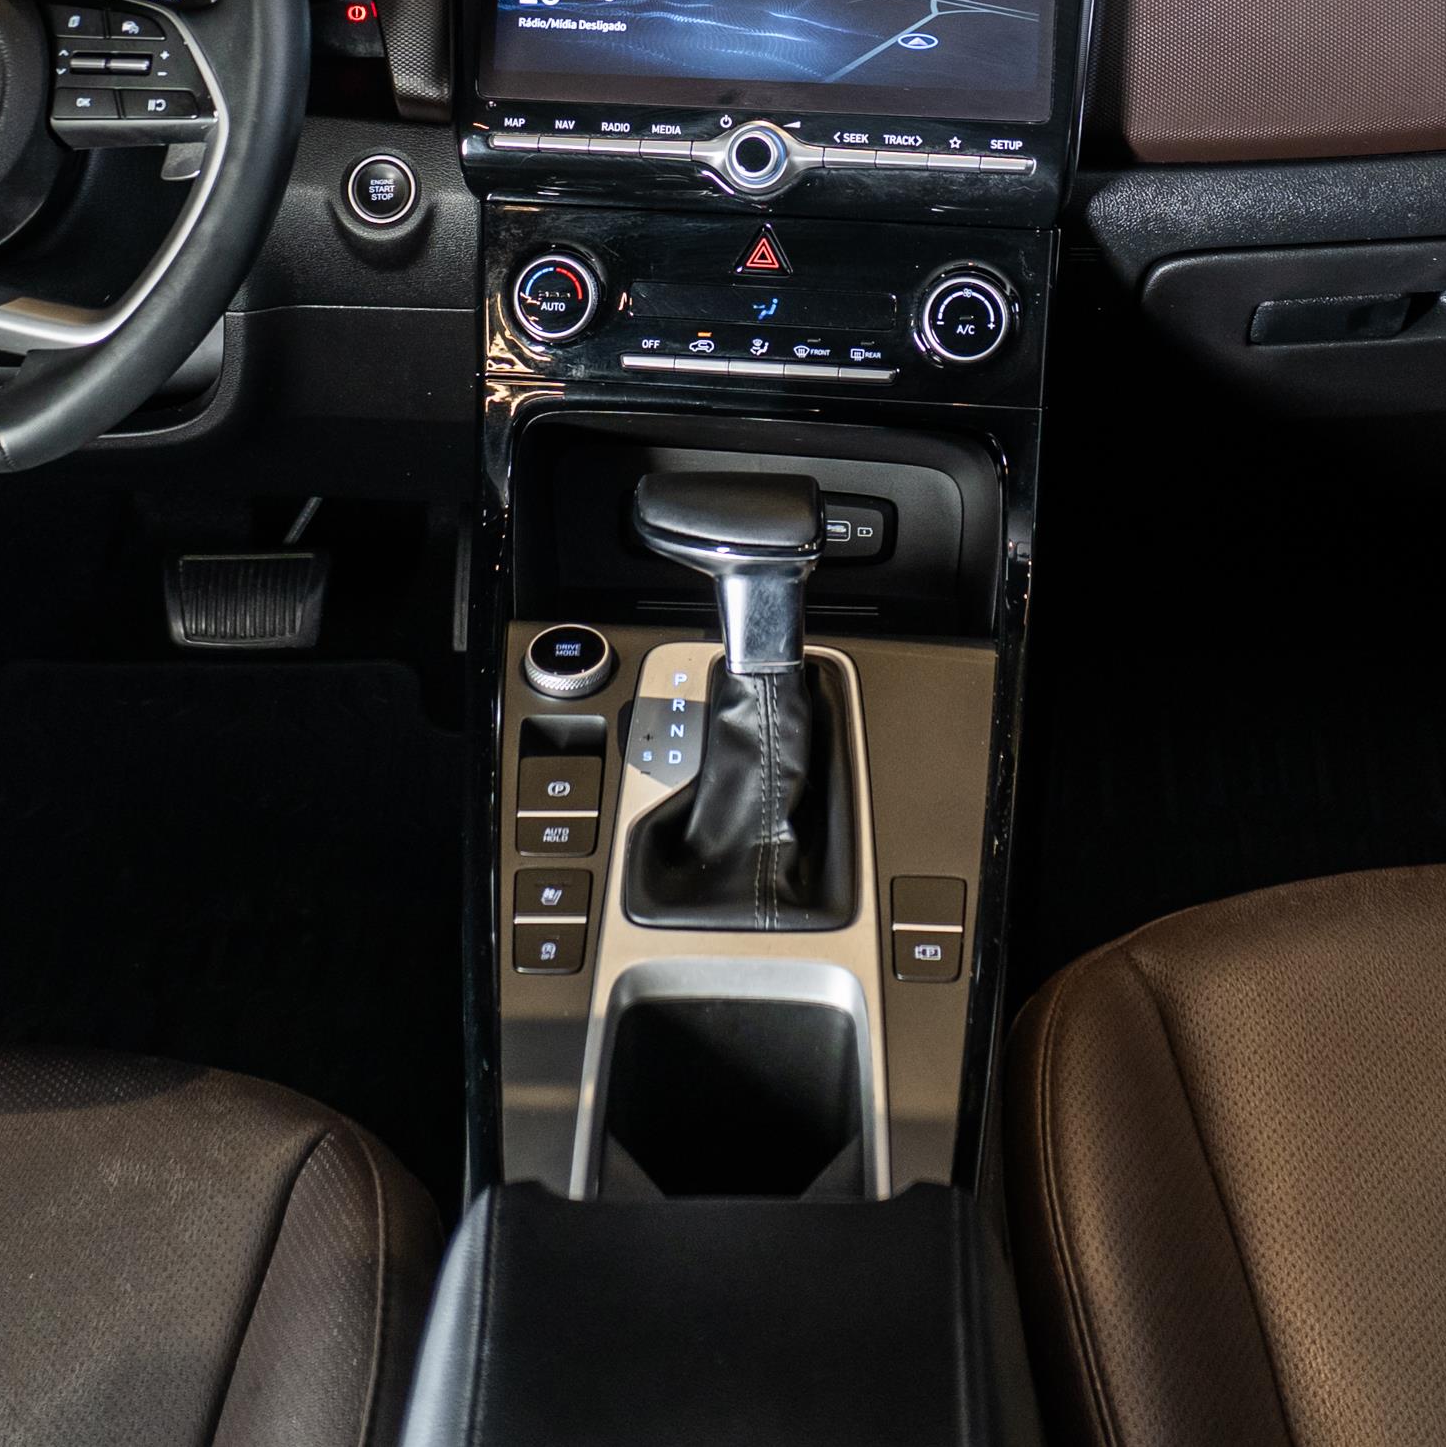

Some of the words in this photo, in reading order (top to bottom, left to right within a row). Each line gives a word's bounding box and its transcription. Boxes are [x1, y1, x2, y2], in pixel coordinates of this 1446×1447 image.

[518, 17, 577, 29] Rádio/Mídia
[578, 19, 627, 32] Desligado
[504, 118, 525, 128] MAP
[555, 120, 575, 130] NAV
[601, 122, 630, 132] RADIO
[651, 124, 681, 135] MEDIA
[843, 133, 869, 144] SEEK
[883, 134, 915, 146] TRACK
[990, 139, 1023, 151] SETUP
[368, 185, 395, 193] START
[371, 193, 394, 201] STOP
[540, 301, 566, 311] AUTO
[956, 324, 975, 335] A/C
[641, 339, 660, 349] OFF
[810, 348, 831, 356] FRONT
[865, 351, 882, 359] REAR
[555, 649, 580, 657] MODE
[674, 673, 687, 686] P
[672, 698, 686, 712] R
[670, 724, 684, 738] N
[643, 751, 652, 762] S
[668, 750, 682, 764] D
[544, 827, 569, 835] AUTO
[543, 834, 568, 842] HOLD
